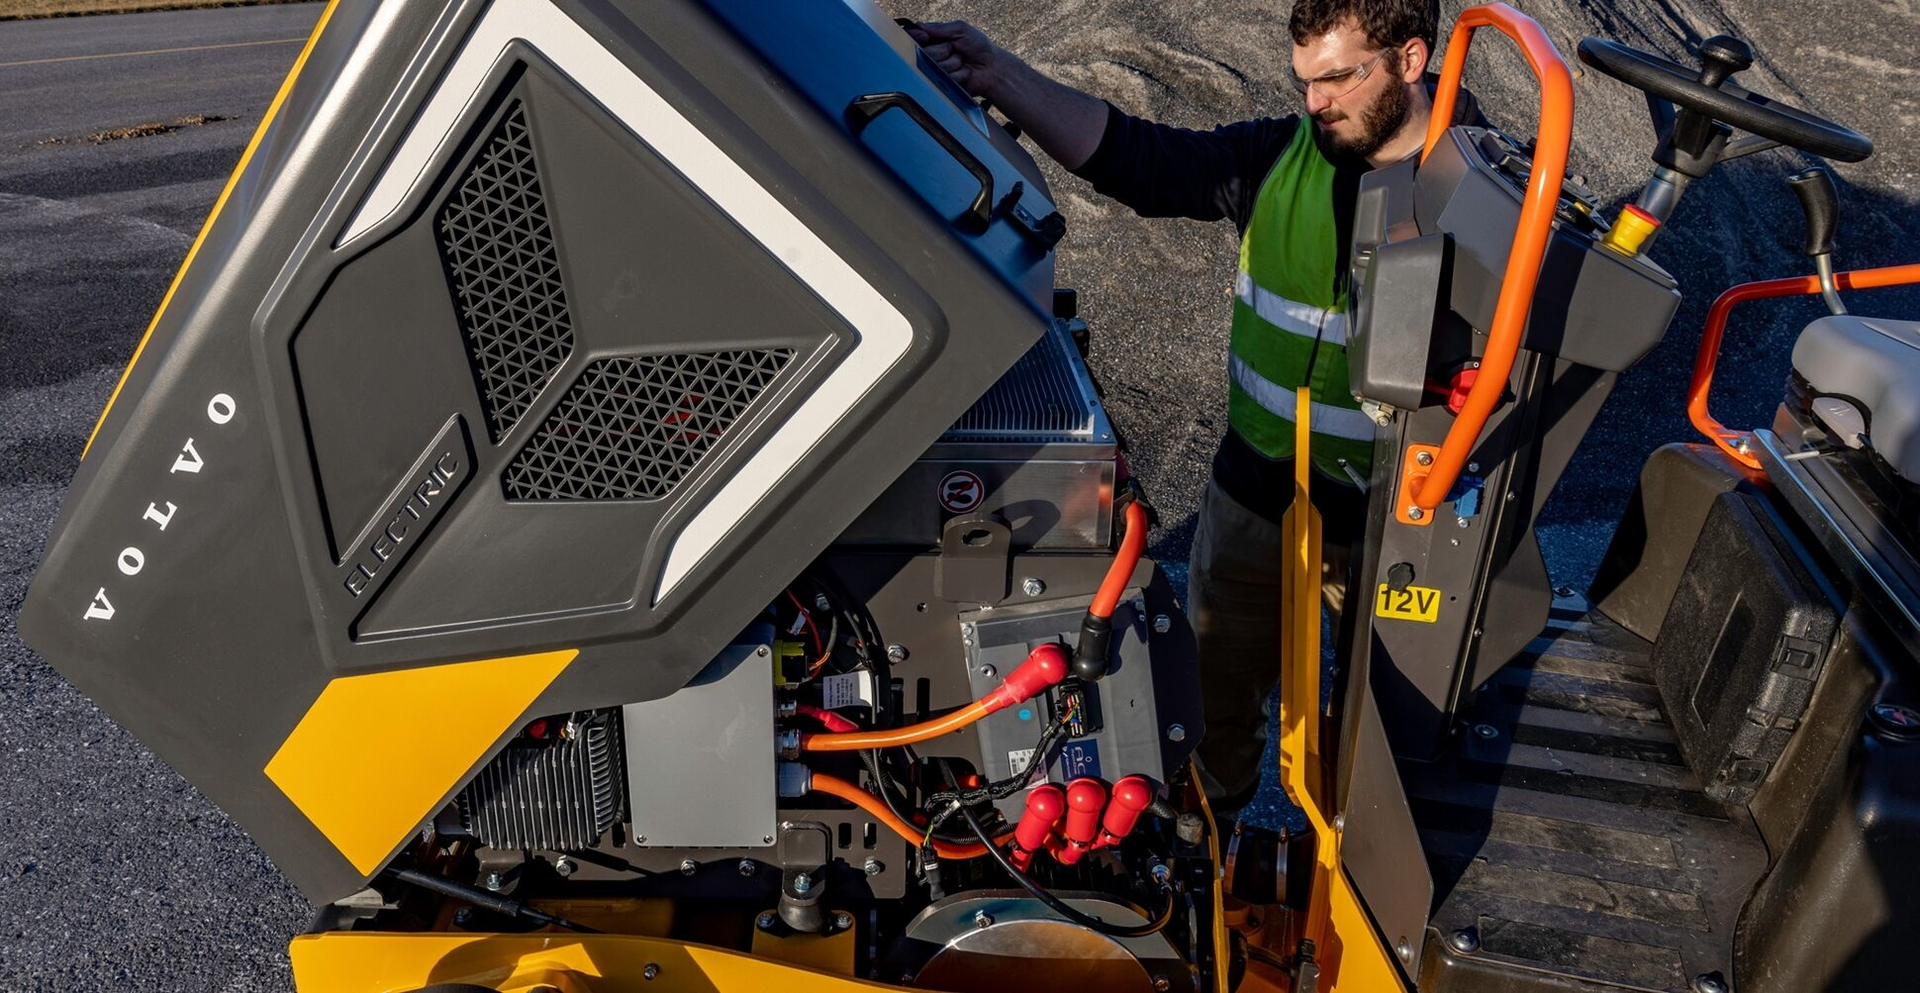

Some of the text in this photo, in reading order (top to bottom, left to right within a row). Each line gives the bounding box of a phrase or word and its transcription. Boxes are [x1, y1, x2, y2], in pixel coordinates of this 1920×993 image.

[83, 393, 236, 621] VOLVO
[344, 451, 459, 598] ELECTRIC
[1381, 588, 1436, 614] 12V
